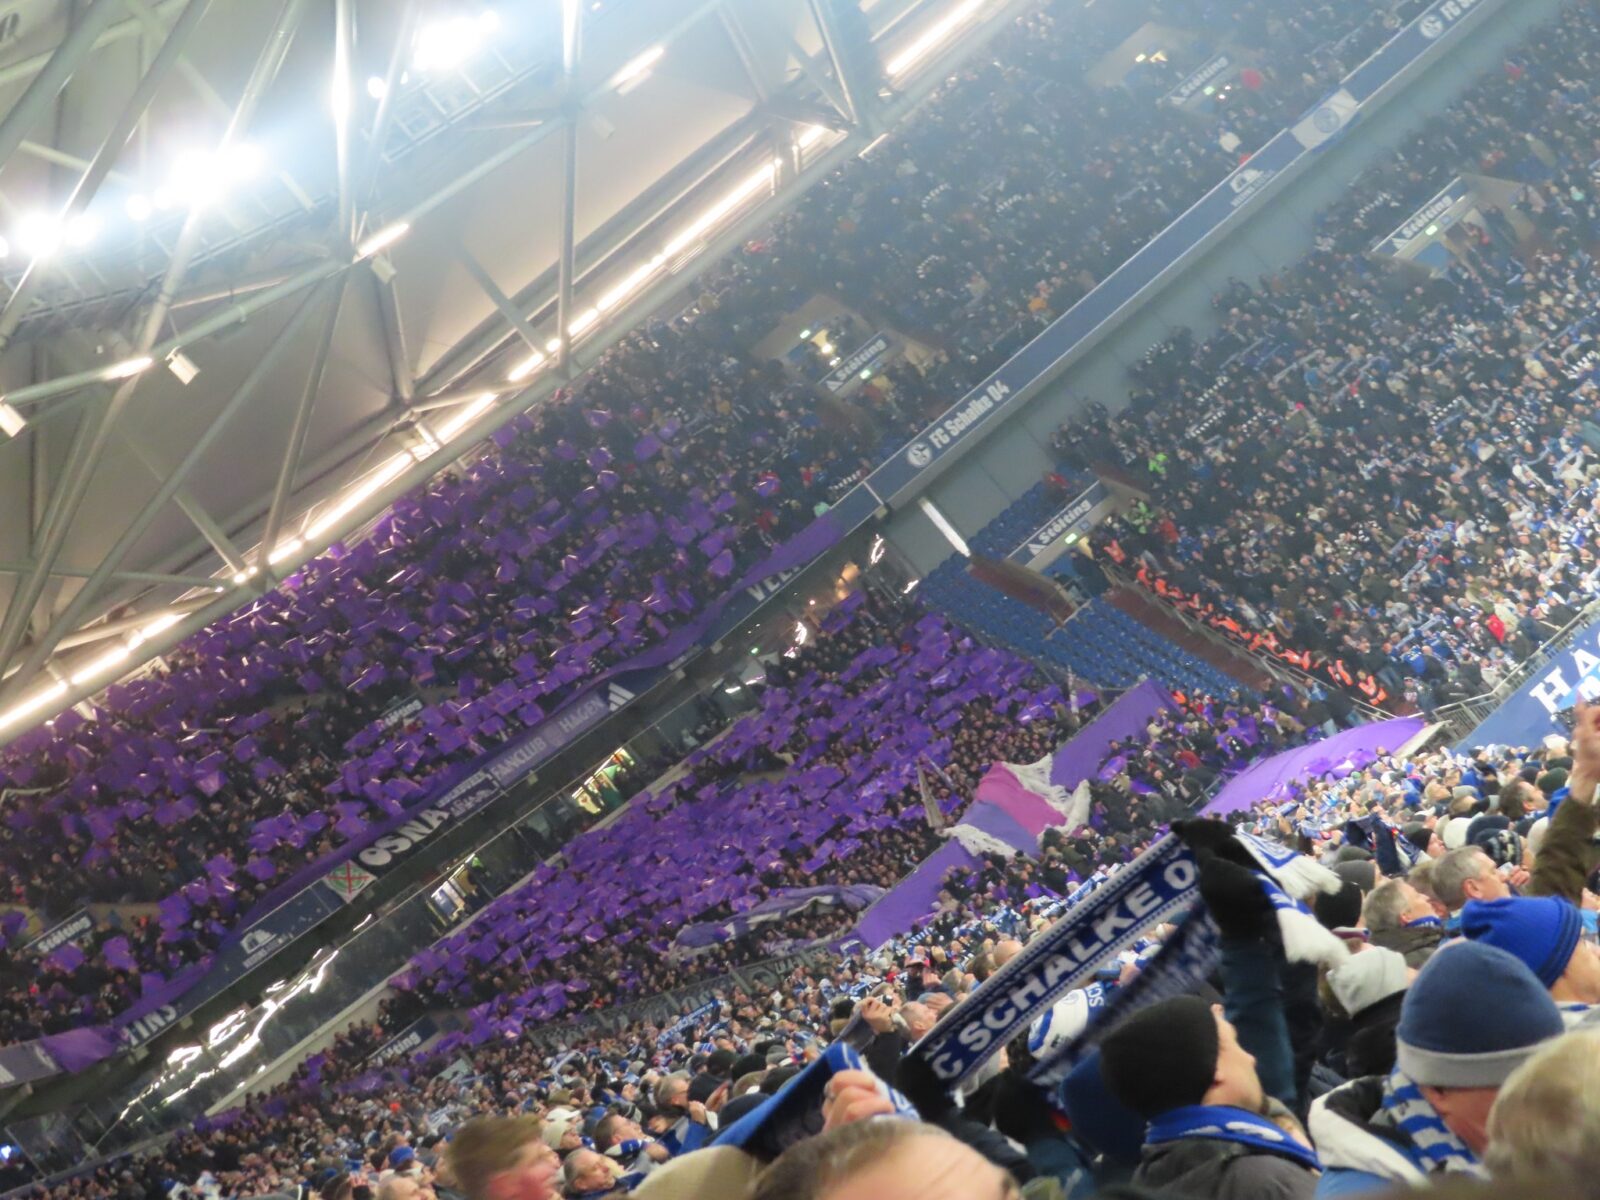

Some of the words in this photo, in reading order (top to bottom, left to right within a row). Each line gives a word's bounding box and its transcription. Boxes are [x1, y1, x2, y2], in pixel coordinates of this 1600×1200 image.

[928, 428, 950, 449] FC
[944, 395, 994, 436] Schalke
[986, 380, 1010, 401] 04
[746, 566, 800, 602] VEL
[1529, 631, 1600, 715] HA
[490, 737, 547, 781] FANCLUB
[558, 694, 605, 733] HAGEN
[359, 809, 450, 866] OSNA
[960, 882, 1162, 1051] SCHALKE
